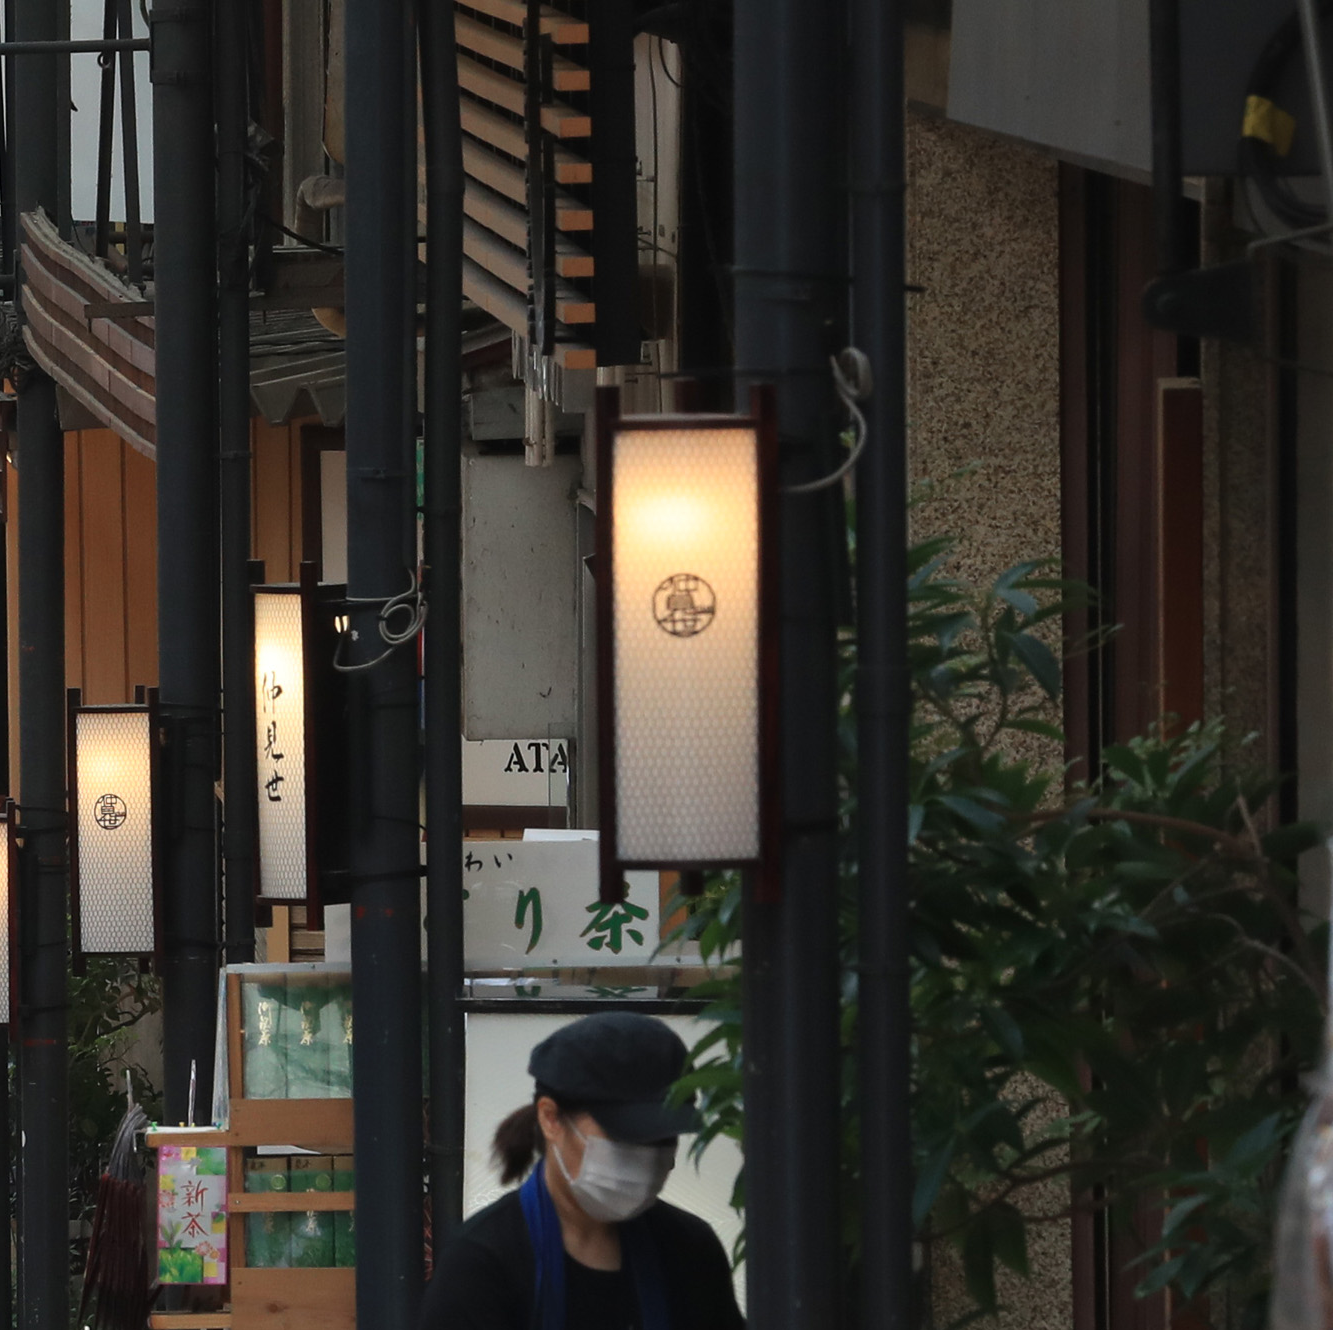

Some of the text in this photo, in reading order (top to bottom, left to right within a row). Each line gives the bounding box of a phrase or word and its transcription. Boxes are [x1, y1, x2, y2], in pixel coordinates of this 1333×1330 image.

[261, 671, 284, 802] 仲見世
[181, 1180, 209, 1239] 新茶
